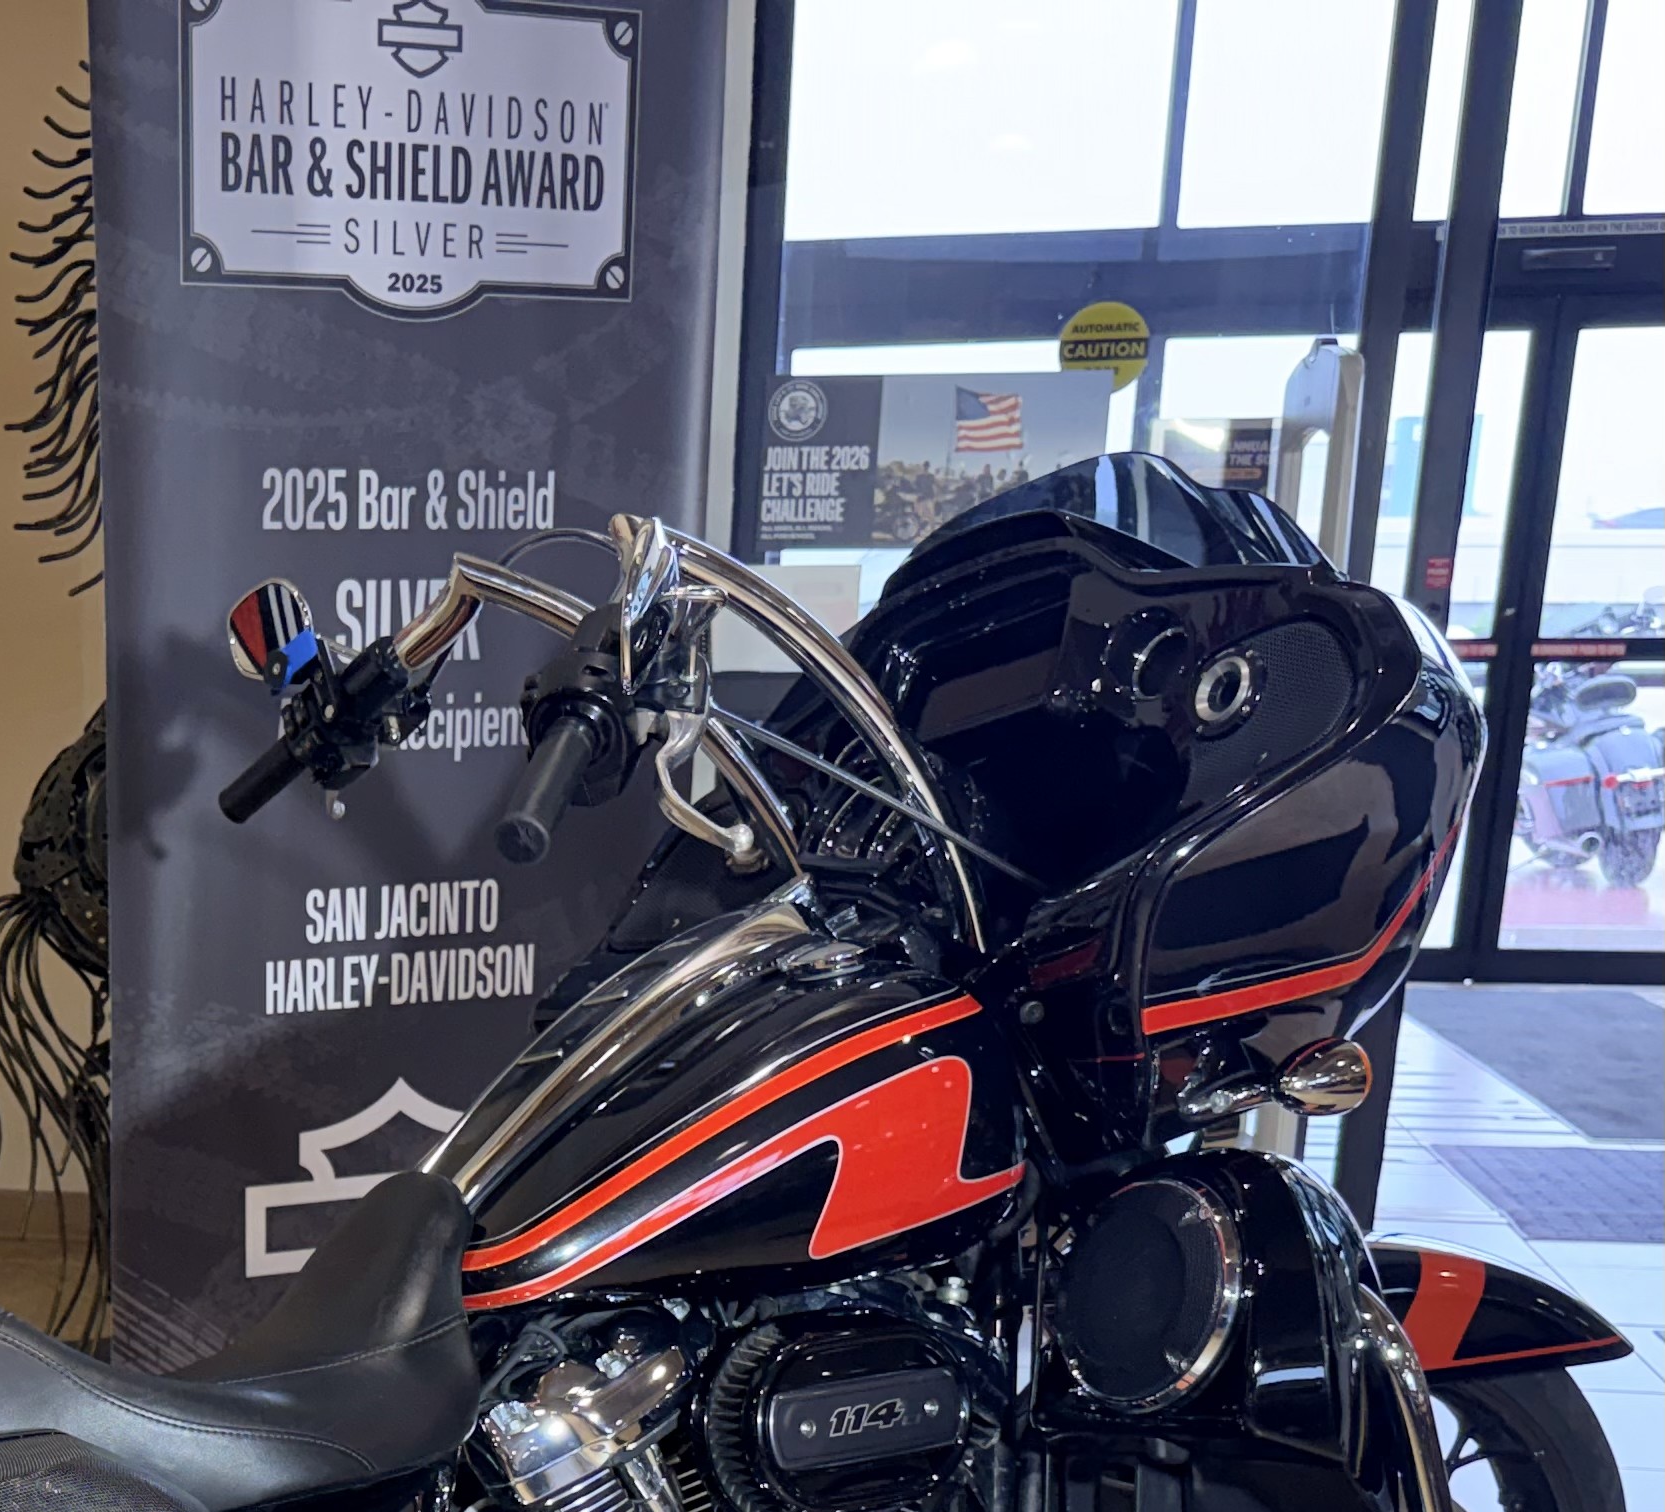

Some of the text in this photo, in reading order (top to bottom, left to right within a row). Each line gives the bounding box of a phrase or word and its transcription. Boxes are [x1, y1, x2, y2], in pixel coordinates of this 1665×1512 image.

[220, 75, 603, 146] HARLEY-DAVIDSON
[220, 131, 605, 213] BAR & SHIELD AWARD
[343, 217, 485, 260] SILVER
[387, 273, 444, 295] 2025
[1071, 322, 1140, 334] AUTOMATIC
[1063, 341, 1146, 359] CAUTION
[763, 445, 871, 471] JOIN THE 2026
[261, 468, 556, 531] 2025 Bar & Shield
[762, 472, 840, 497] LET'S RIDE
[760, 498, 846, 523] CHALLENGE
[304, 878, 499, 945] SAN JACINTO
[264, 943, 535, 1015] HARLEY-DAVIDSON
[829, 1397, 906, 1438] 114
